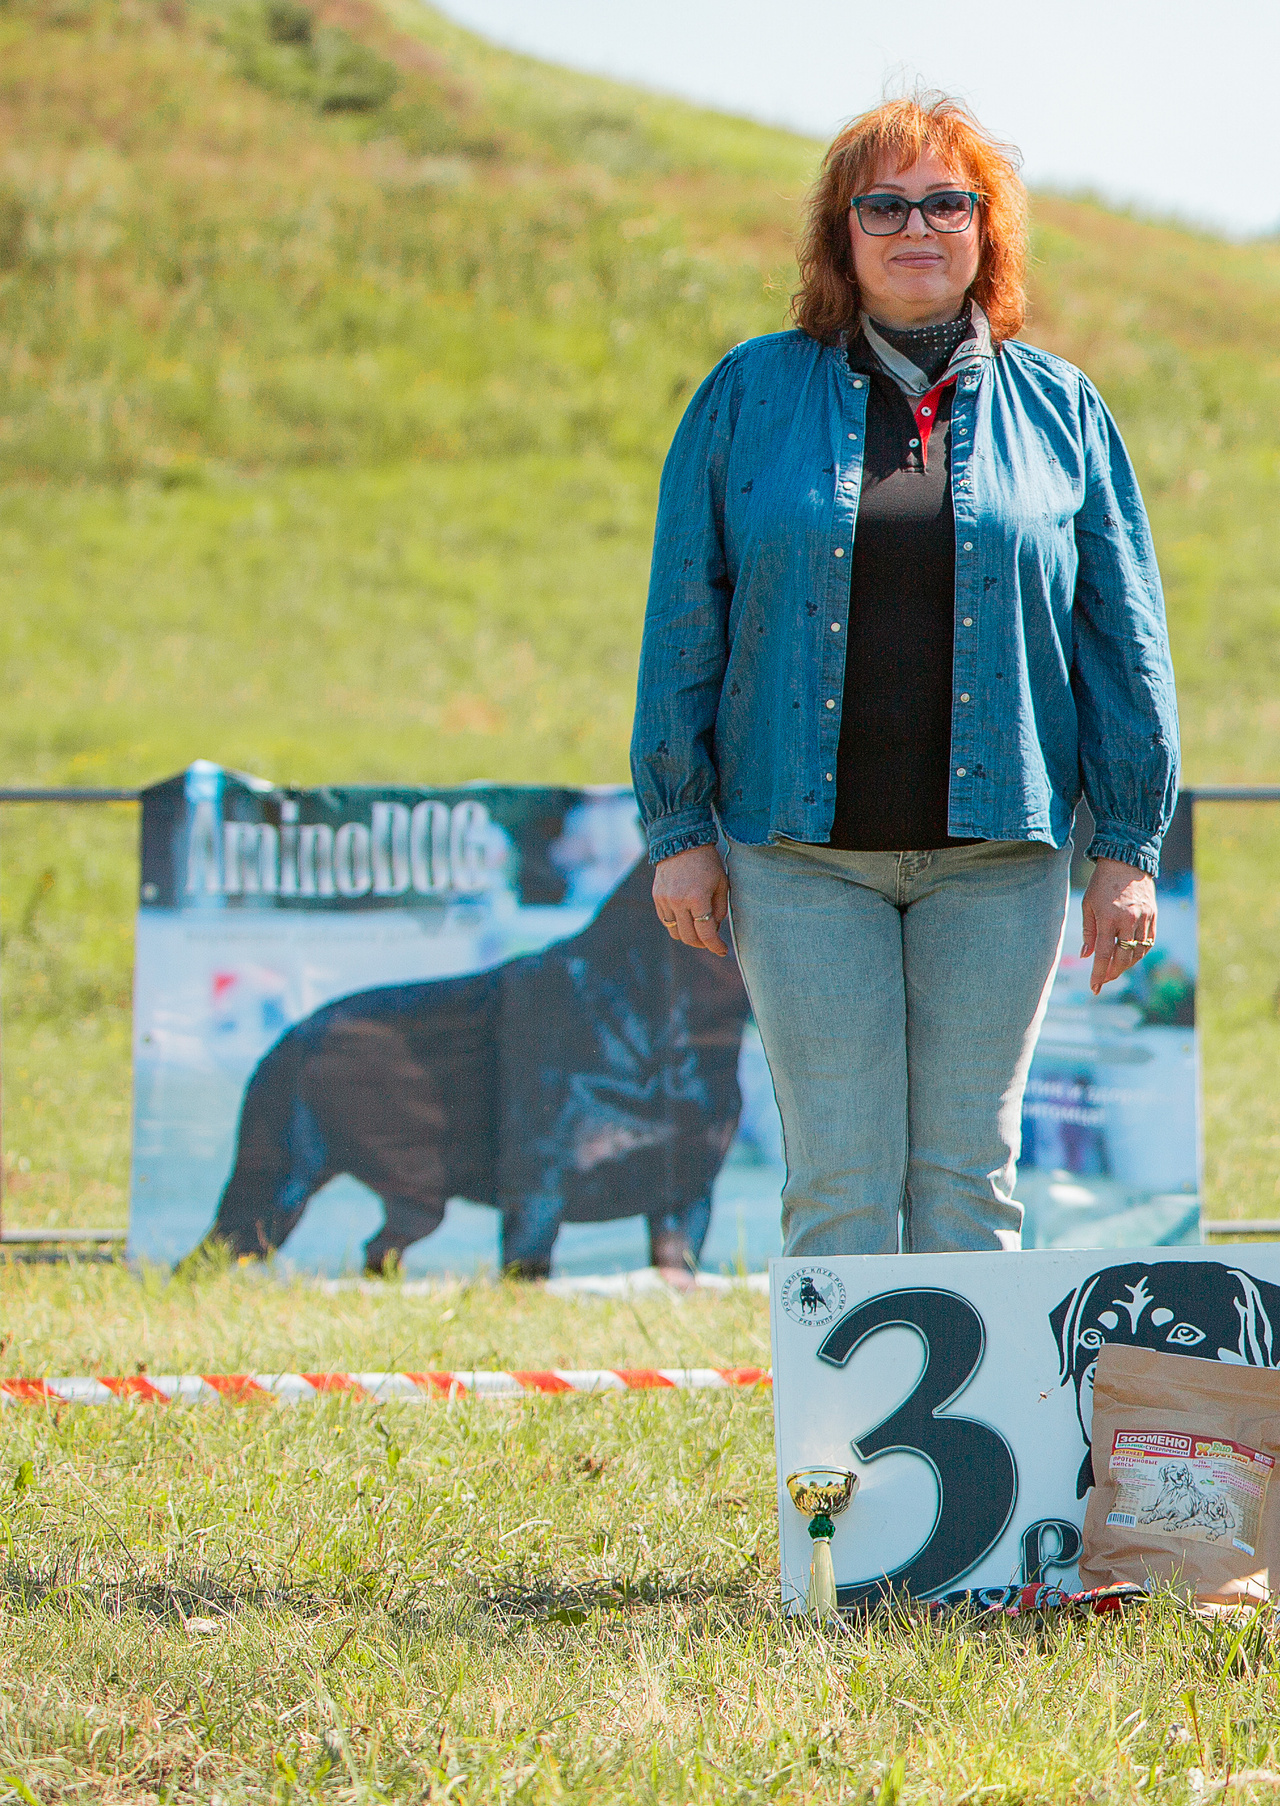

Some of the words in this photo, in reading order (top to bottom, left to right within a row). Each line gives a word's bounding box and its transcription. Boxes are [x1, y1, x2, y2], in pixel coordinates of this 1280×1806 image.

[185, 799, 495, 899] AminoDOG
[782, 1269, 806, 1312] РОТВЕЙЛЕР
[810, 1268, 833, 1278] КЛУБ
[834, 1277, 846, 1310] РОССИИ
[817, 1286, 1019, 1611] 3
[1113, 1456, 1158, 1466] ПРОТЕИНОВЫЕ
[1120, 1434, 1188, 1449] ЗООМЕНЮ
